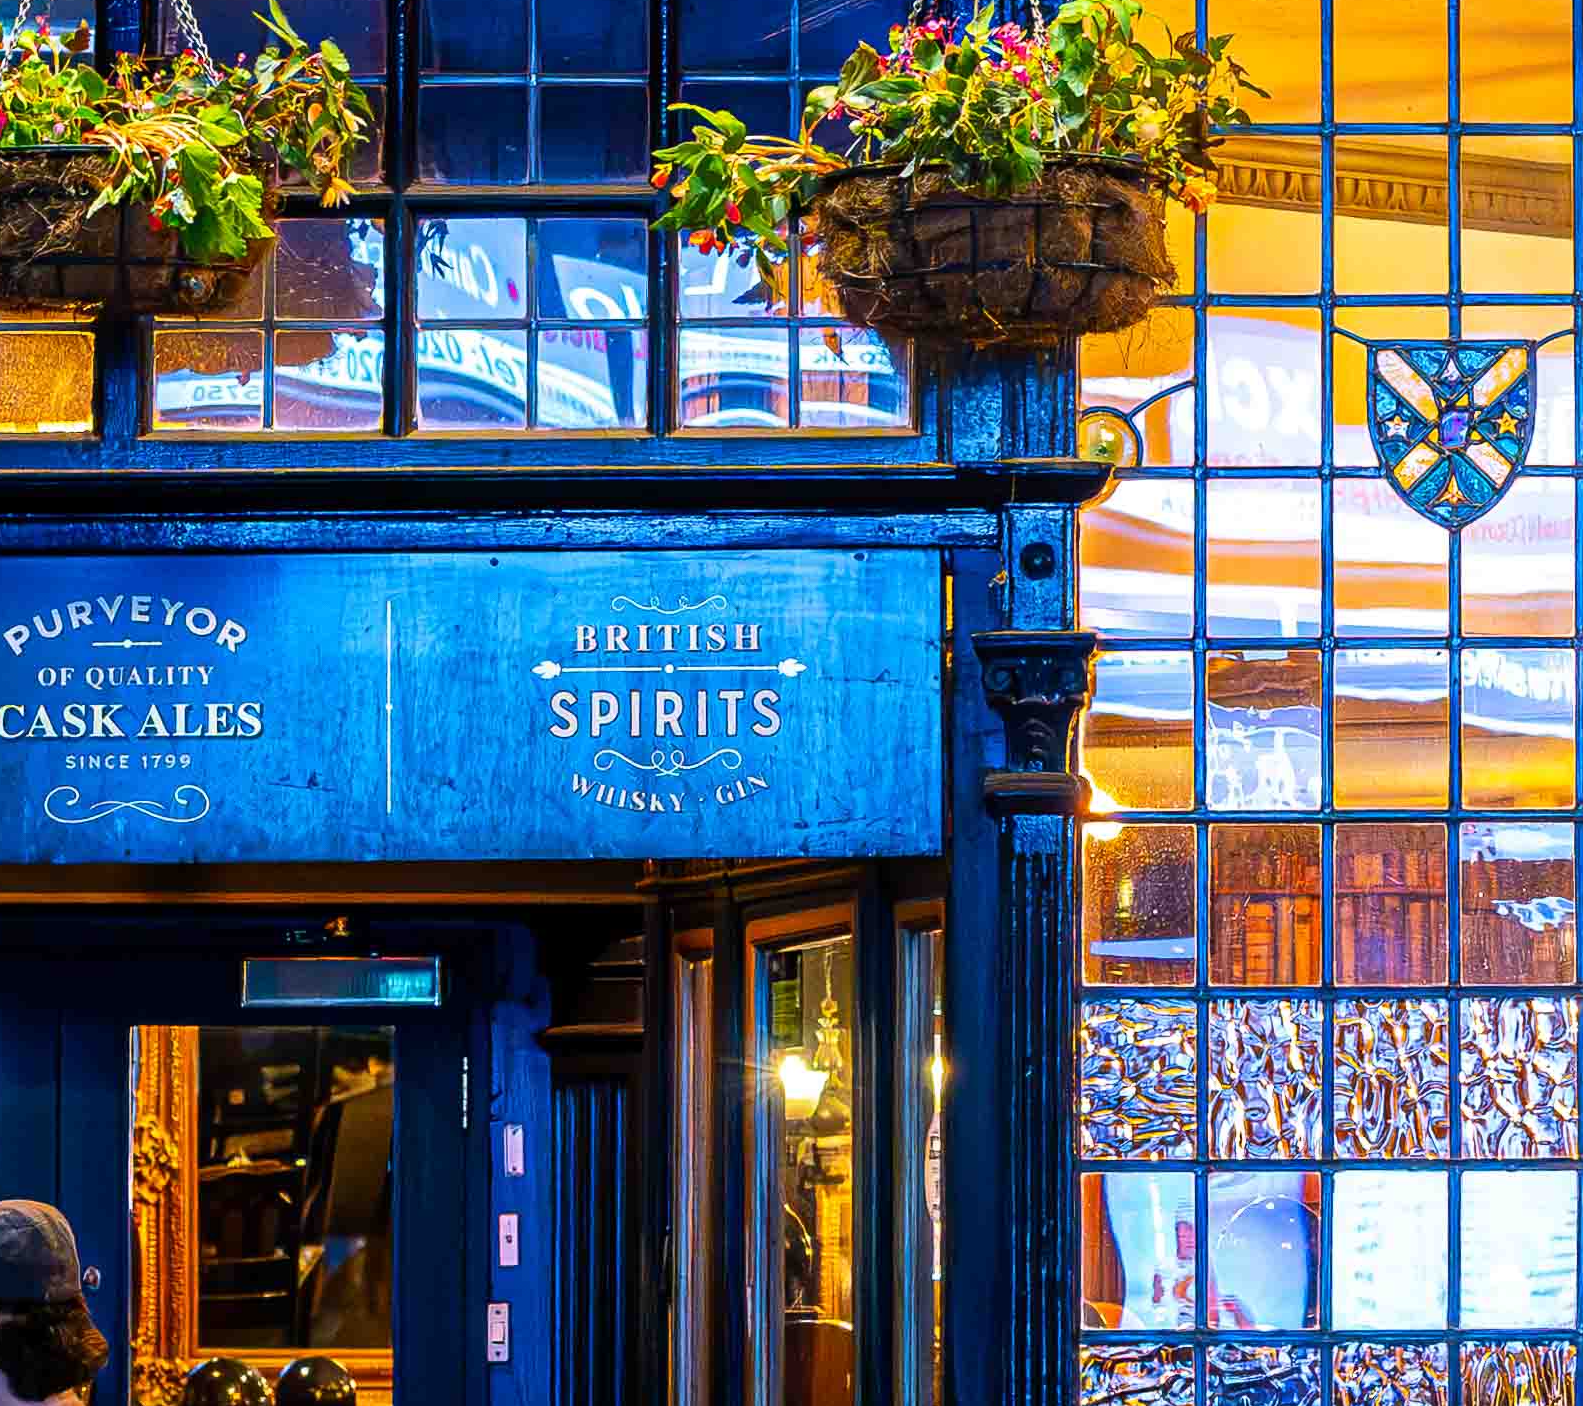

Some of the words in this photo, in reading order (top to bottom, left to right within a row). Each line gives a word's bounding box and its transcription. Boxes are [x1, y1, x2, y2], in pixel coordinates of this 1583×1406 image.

[2, 595, 248, 656] PURVEYOR
[573, 624, 762, 653] BRITISH
[37, 666, 75, 687] OF
[85, 666, 215, 690] QUALITY
[138, 702, 264, 738] ALES
[549, 689, 783, 738] SPIRITS
[65, 754, 130, 770] SINCE
[141, 754, 193, 770] 1799
[571, 773, 685, 812] WHISKY
[714, 773, 770, 806] GIN
